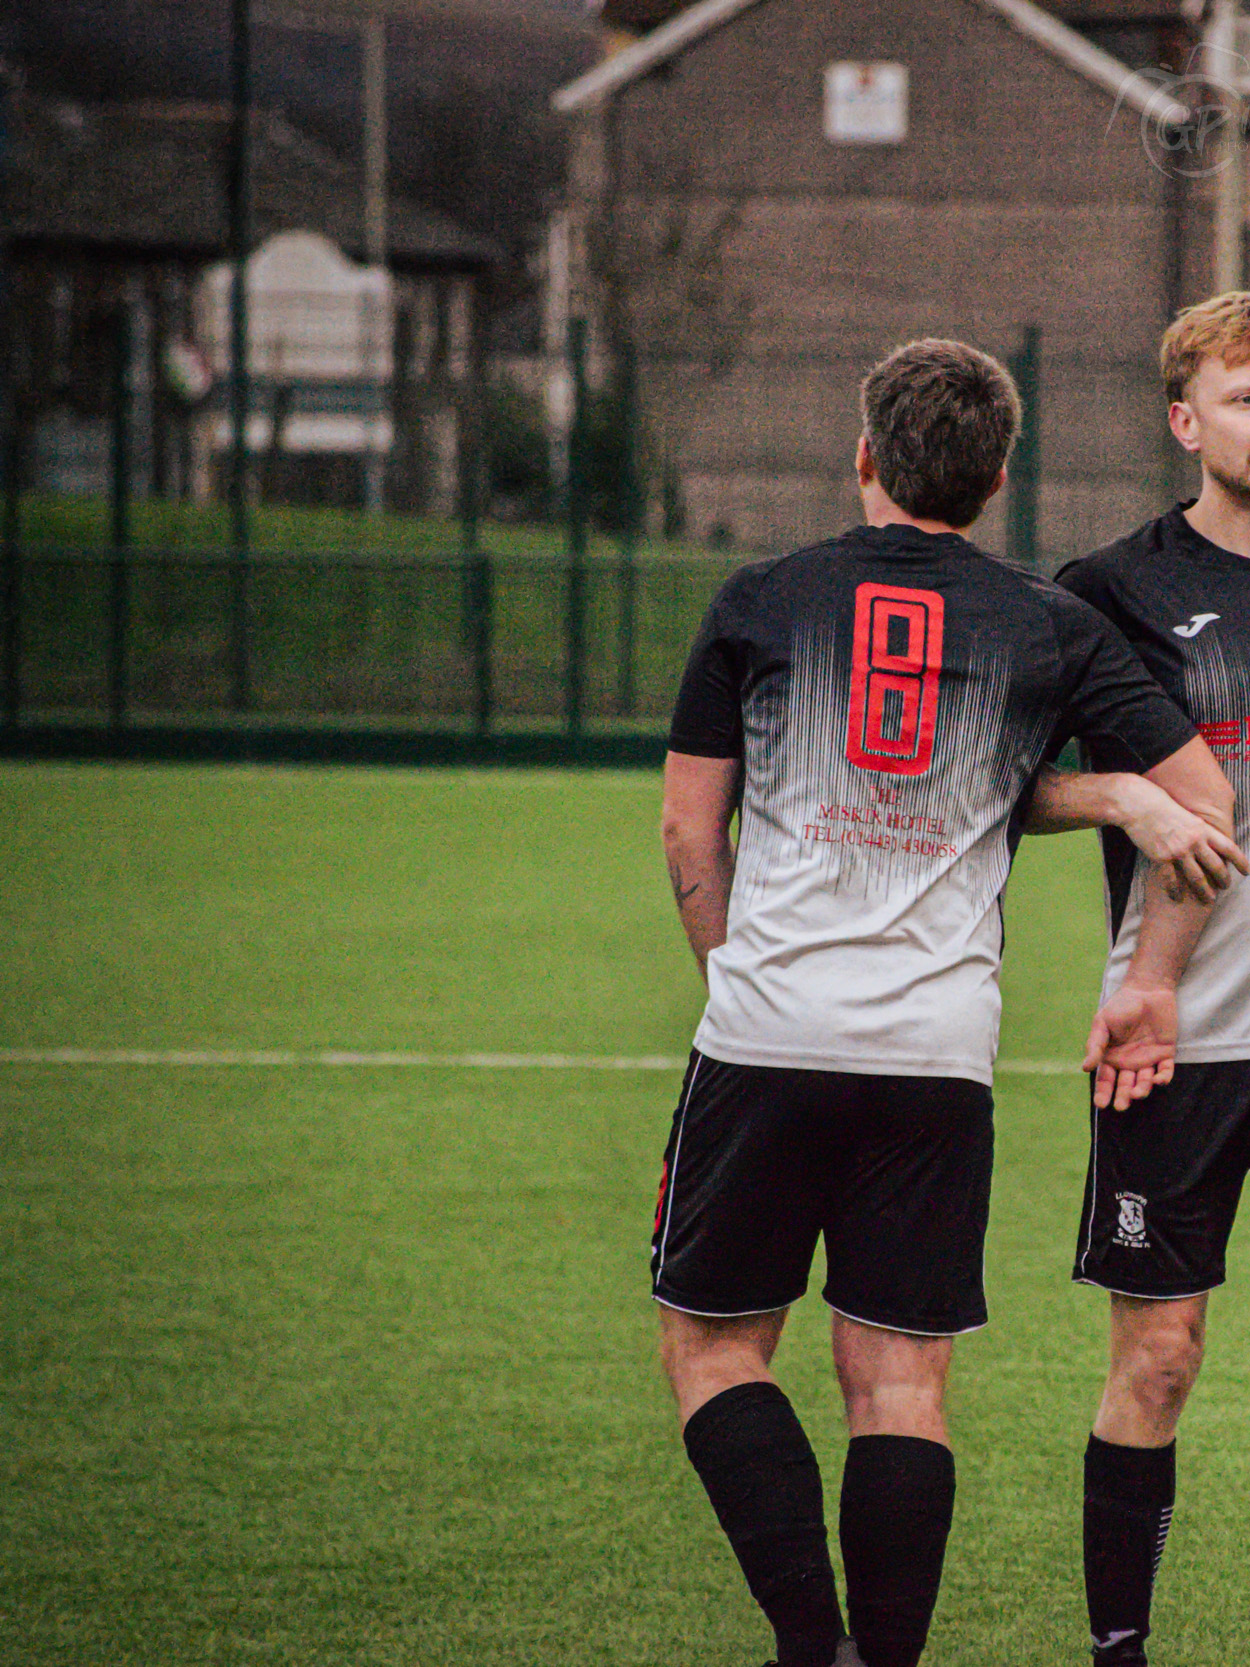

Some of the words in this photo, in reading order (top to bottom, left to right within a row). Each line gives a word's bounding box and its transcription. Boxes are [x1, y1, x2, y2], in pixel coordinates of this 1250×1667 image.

[846, 582, 944, 776] 8
[869, 785, 904, 806] THE
[817, 803, 883, 825] MISKIN
[886, 811, 947, 836] HOTEL
